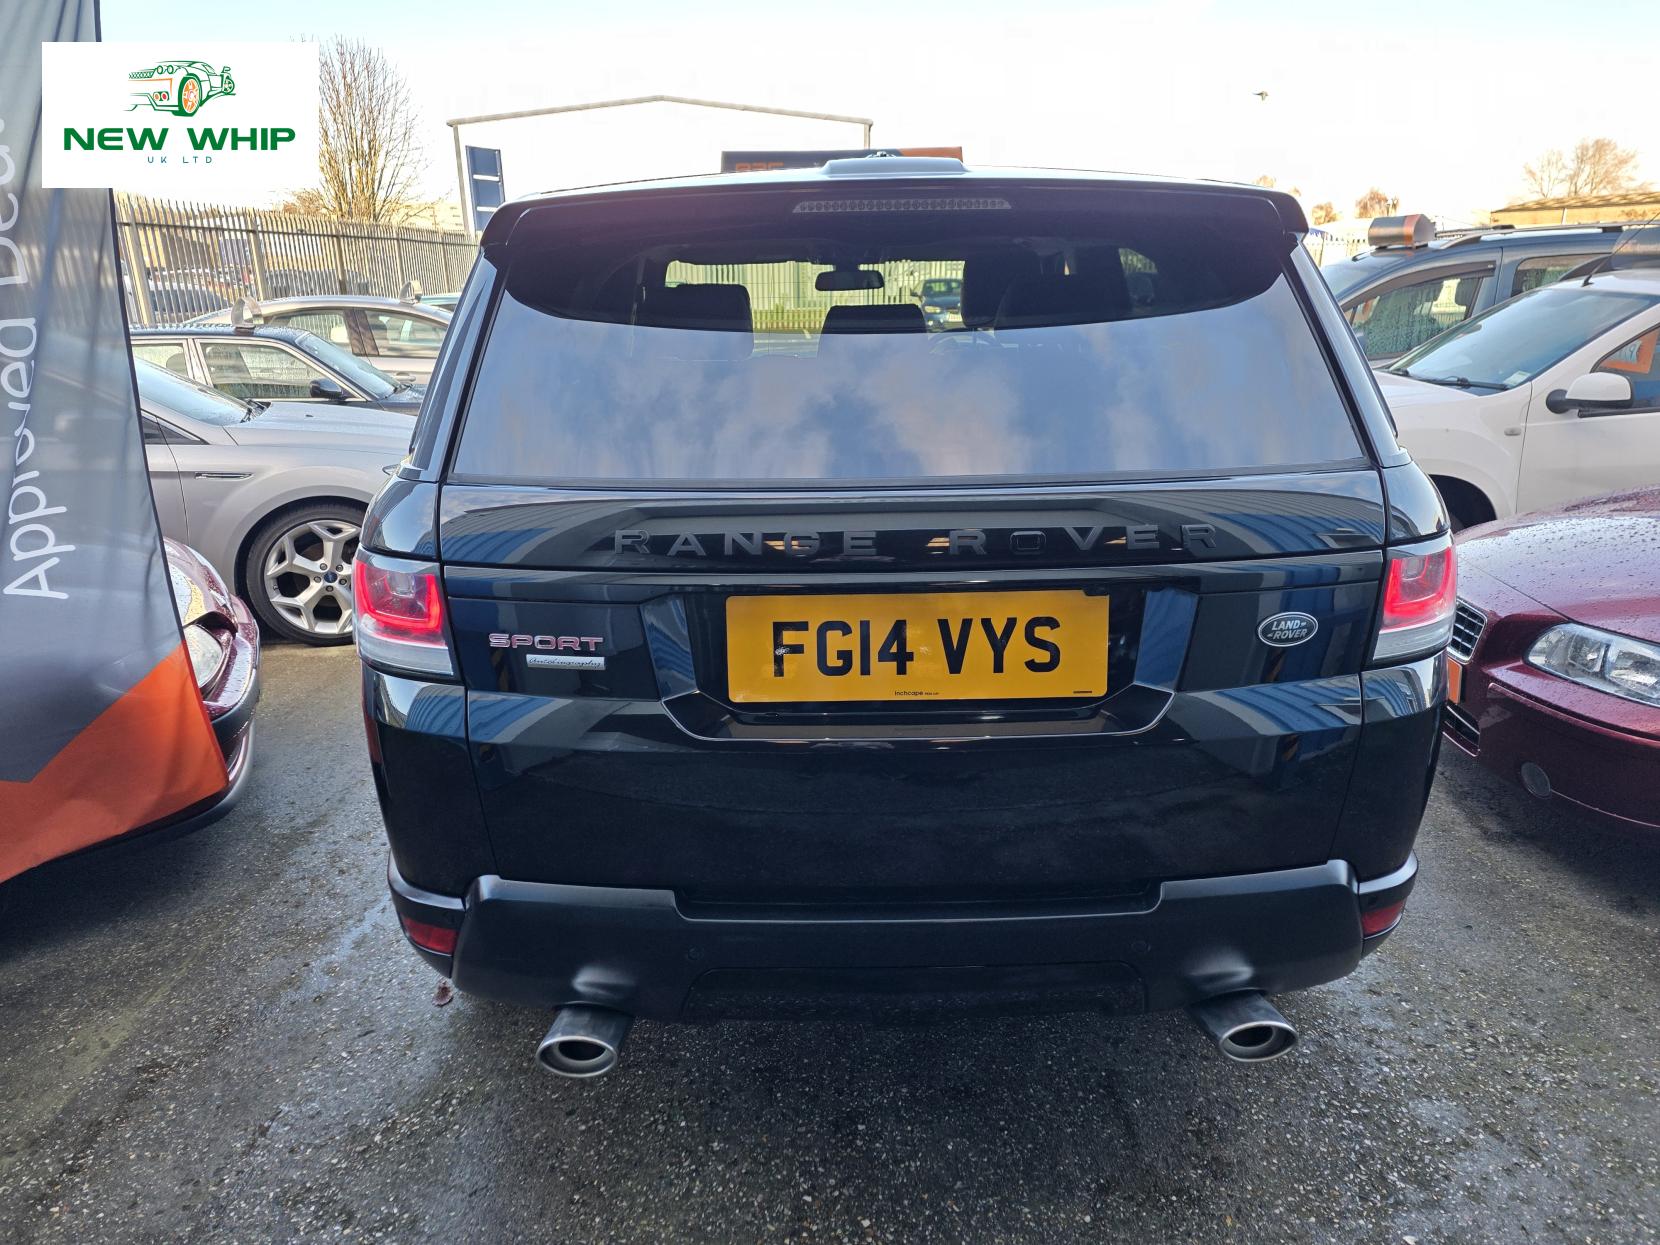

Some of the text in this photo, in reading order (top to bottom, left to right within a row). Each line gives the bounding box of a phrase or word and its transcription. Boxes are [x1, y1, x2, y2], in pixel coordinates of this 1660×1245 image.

[614, 523, 1217, 556] RANGE ROVER
[1272, 620, 1300, 631] LAND
[1272, 628, 1308, 640] ROVER
[488, 633, 604, 651] SPORT
[772, 616, 1061, 677] FG14 VYS
